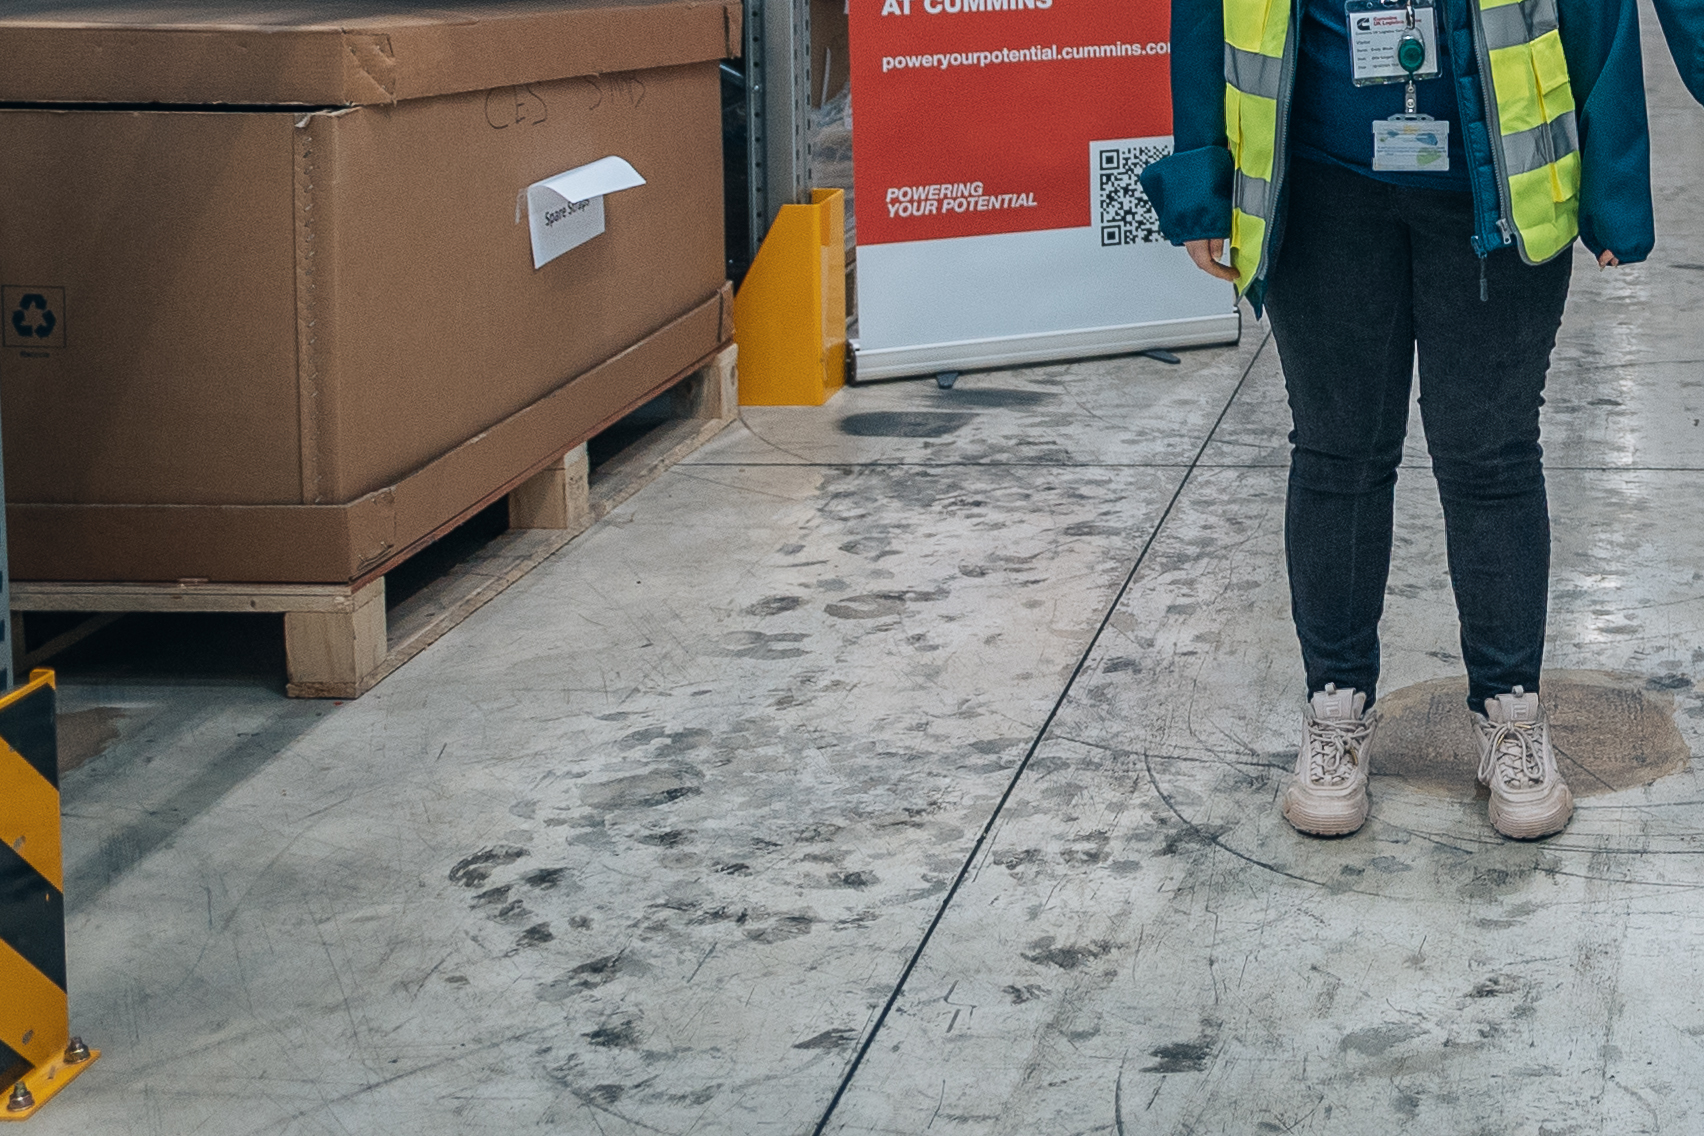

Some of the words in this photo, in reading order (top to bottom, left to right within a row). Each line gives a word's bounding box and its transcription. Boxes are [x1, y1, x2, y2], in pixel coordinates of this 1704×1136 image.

[886, 181, 984, 203] POWERING
[887, 199, 938, 218] YOUR
[941, 192, 1038, 214] POTENTIAL
[545, 207, 567, 228] Spare
